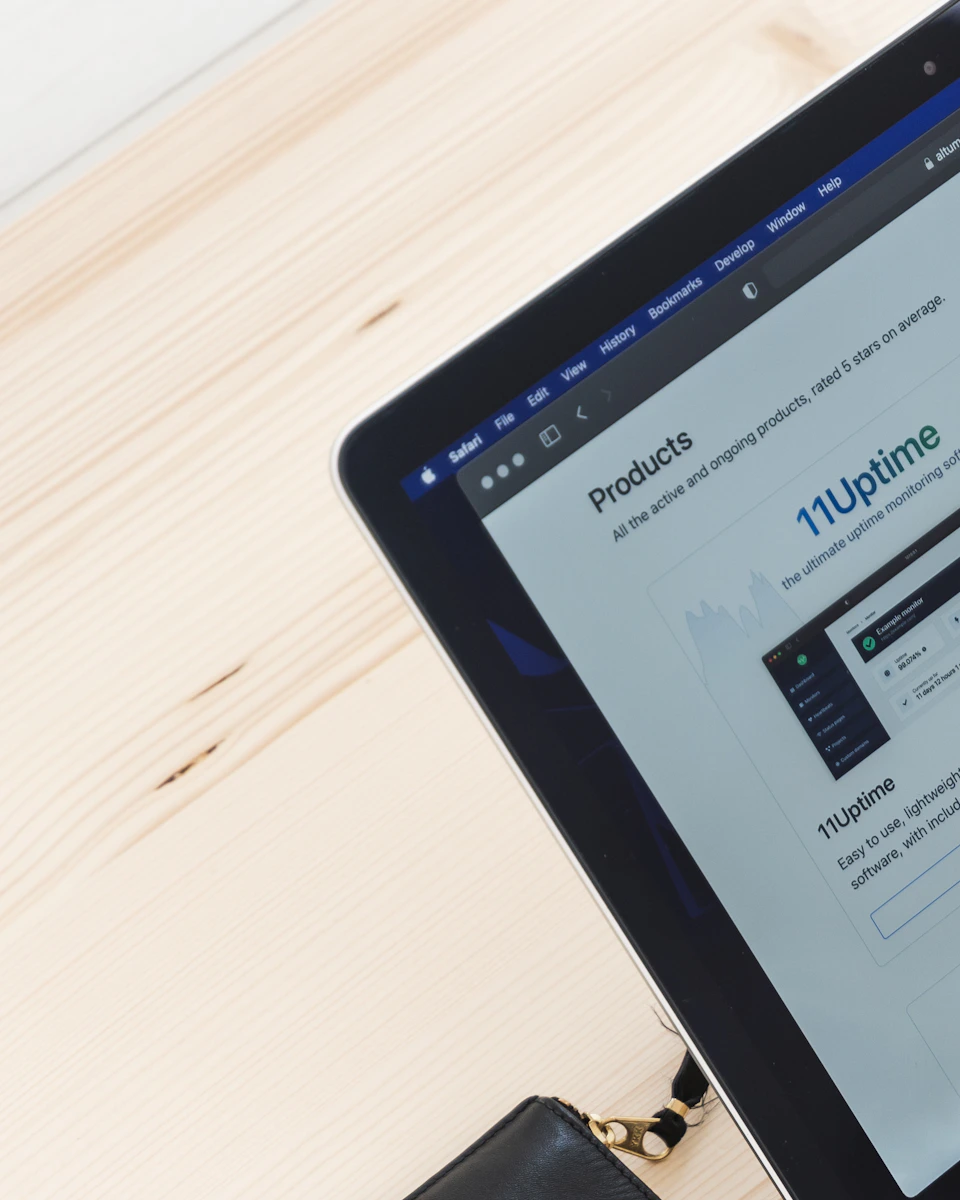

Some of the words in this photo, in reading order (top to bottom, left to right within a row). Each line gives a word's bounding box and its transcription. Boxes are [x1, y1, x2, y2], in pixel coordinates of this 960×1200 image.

[448, 432, 483, 463] Safari
[494, 412, 515, 430] File
[526, 386, 549, 407] Edit
[560, 359, 587, 381] View
[599, 324, 636, 354] History
[647, 276, 703, 319] Bookmarks
[714, 239, 755, 271] Develop
[766, 201, 806, 233] Window
[817, 176, 842, 197] Help
[613, 523, 629, 542] All
[628, 511, 649, 529] the
[650, 484, 685, 514] active
[686, 463, 709, 488] and
[709, 431, 757, 470] ongoing
[756, 394, 811, 438] products,
[810, 366, 842, 396] rated
[840, 358, 852, 372] 5
[852, 340, 881, 365] stars
[881, 328, 898, 343] on
[897, 295, 946, 332] average.
[587, 431, 693, 513] Products
[796, 424, 940, 536] 11Uptime
[781, 572, 802, 590] the
[801, 538, 846, 575] ultimate
[846, 509, 885, 542] uptime
[884, 466, 944, 513] monitoring
[875, 614, 902, 635] Example
[901, 597, 923, 617] monitor
[922, 684, 935, 695] days
[940, 668, 956, 681] hours
[817, 777, 895, 839] 11Uptime
[837, 844, 865, 870] Easy
[865, 835, 879, 848] to
[879, 818, 906, 838] use,
[850, 849, 903, 890] software,
[902, 826, 928, 849] with
